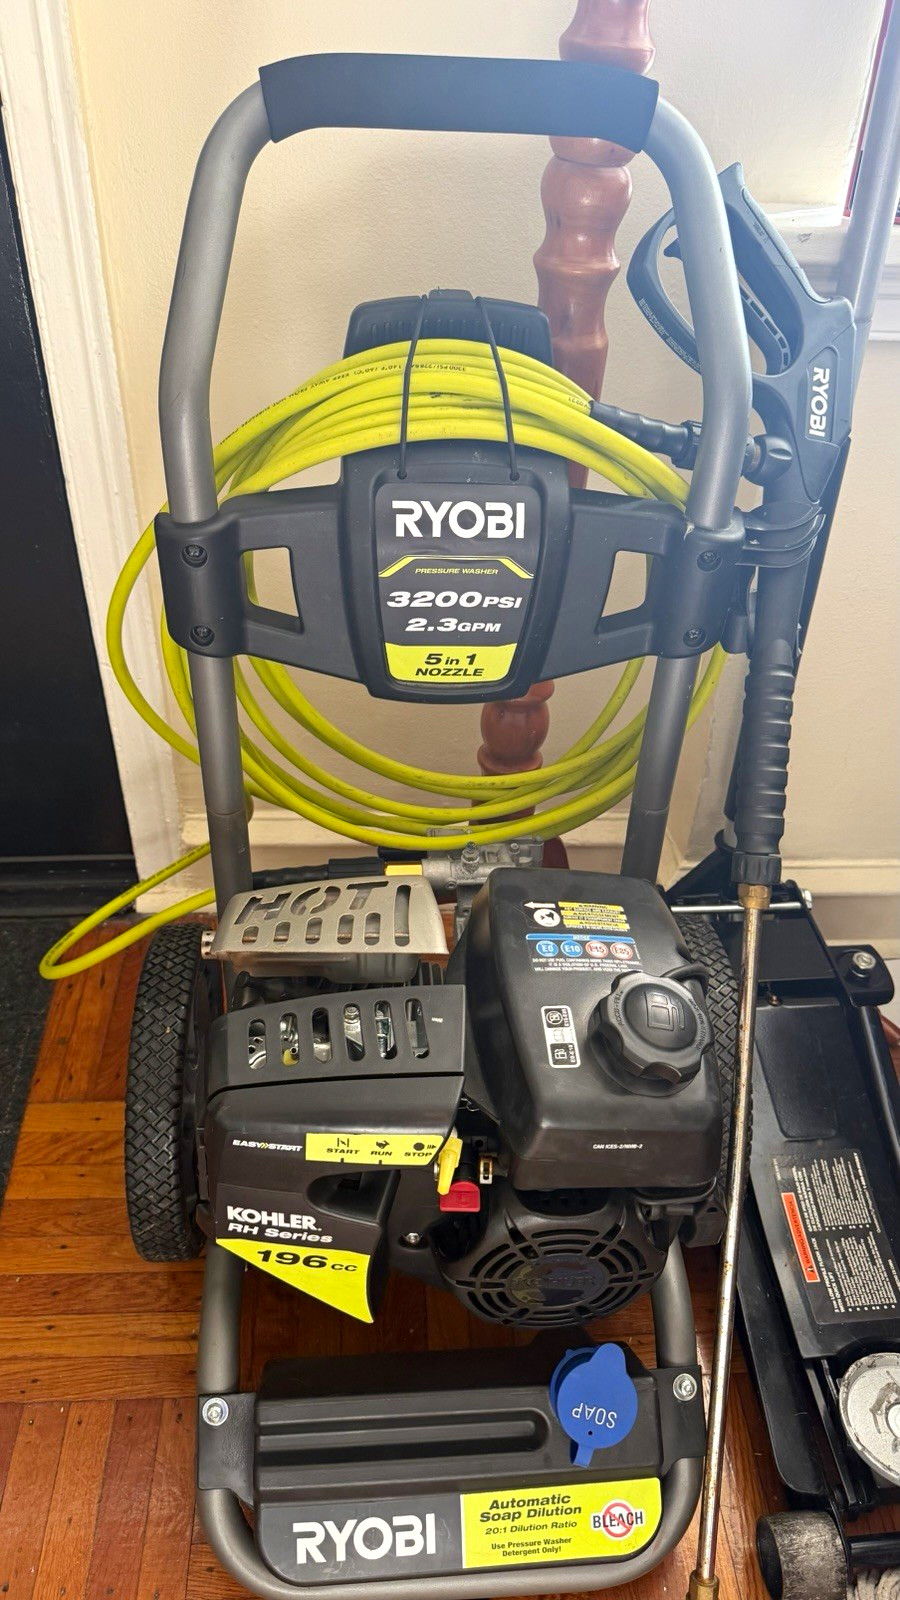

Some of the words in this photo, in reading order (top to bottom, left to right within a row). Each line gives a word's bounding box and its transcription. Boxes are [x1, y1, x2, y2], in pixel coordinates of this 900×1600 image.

[808, 366, 830, 437] RYOBI
[392, 500, 526, 539] RYOBI
[424, 653, 443, 665] 5
[445, 656, 460, 665] in
[466, 653, 477, 665] 1
[415, 668, 485, 677] NOZZLE
[234, 881, 389, 925] HOT
[543, 945, 555, 953] E0
[564, 945, 581, 953] E10
[589, 945, 605, 954] E15
[326, 1148, 360, 1156] START
[788, 1200, 804, 1239] ADVERTENCIA
[228, 1223, 259, 1236] RH
[264, 1228, 333, 1244] Series
[800, 1239, 811, 1266] WARNING
[815, 1250, 823, 1266] FLOOR
[821, 1268, 830, 1287] PROFILE
[571, 1402, 618, 1429] SOAP
[489, 1494, 572, 1511] Automatic
[479, 1510, 522, 1524] Soap
[526, 1505, 582, 1519] Dilution
[593, 1511, 643, 1529] BLEACH
[485, 1526, 508, 1535] 20:1
[510, 1523, 549, 1534] Dilution
[551, 1520, 578, 1529] Ratio
[292, 1513, 437, 1565] RYOBI
[507, 1539, 542, 1549] Pressure
[543, 1537, 572, 1546] Washer
[502, 1548, 540, 1558] Detergent
[542, 1546, 562, 1555] Only!
